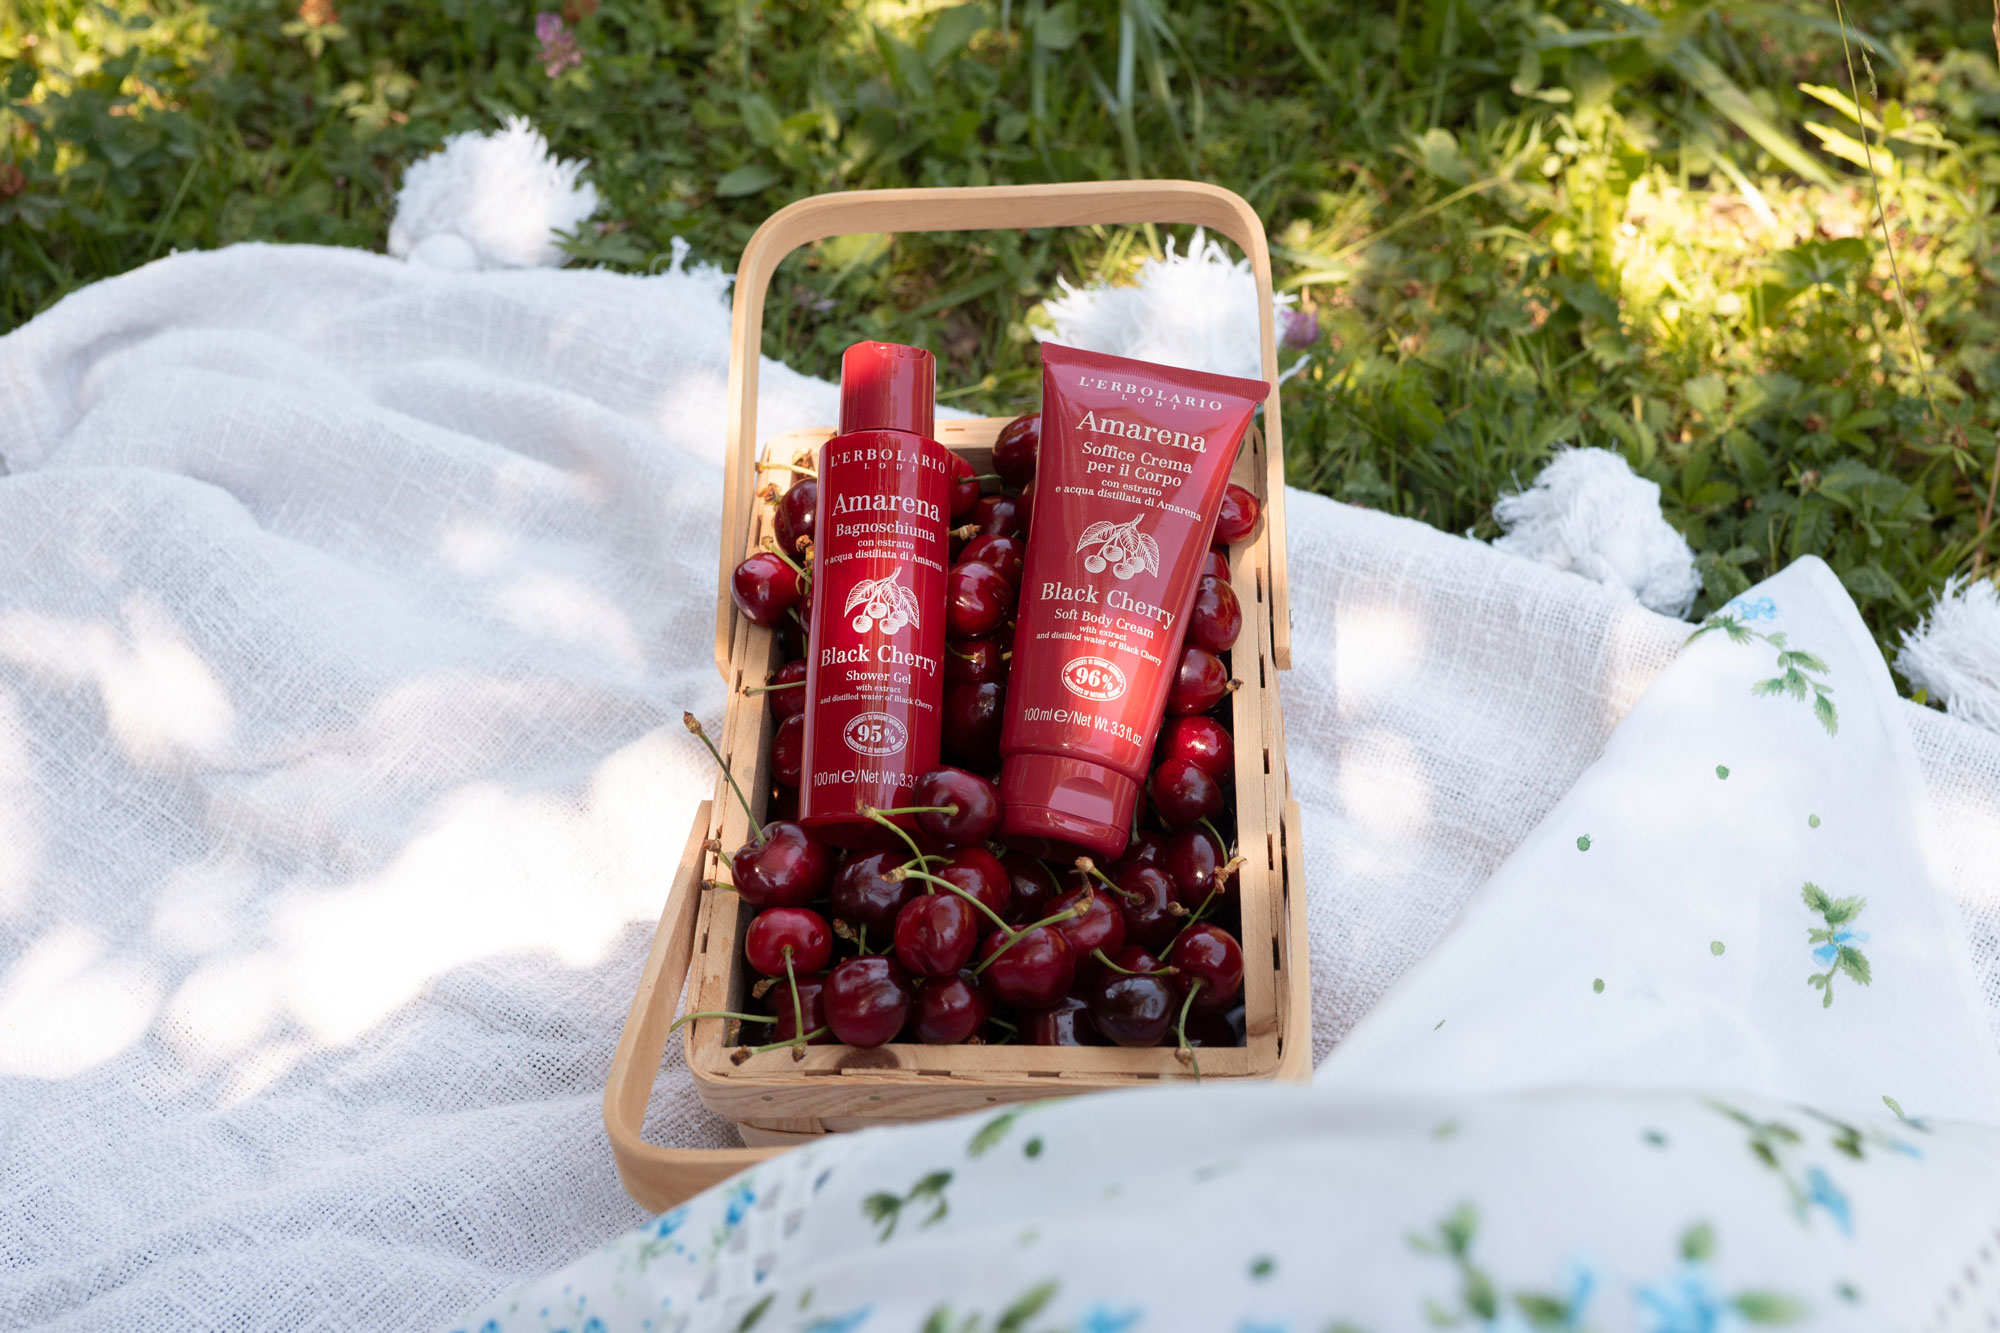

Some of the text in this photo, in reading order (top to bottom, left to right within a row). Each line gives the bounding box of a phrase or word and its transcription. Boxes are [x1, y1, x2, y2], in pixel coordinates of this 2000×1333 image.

[1079, 376, 1223, 411] L'ERBOLARIO
[1121, 394, 1177, 410] LODI
[1076, 410, 1207, 454] Amarena
[831, 448, 946, 474] L'ERBOLARIO
[864, 462, 916, 473] LODI
[1082, 442, 1193, 474] Soffice Crema
[1086, 460, 1182, 487] per il Corpo
[1101, 478, 1162, 497] con estratto
[832, 493, 940, 522] Amarena
[1064, 485, 1094, 498] acqua
[1097, 487, 1141, 505] distillata
[1144, 497, 1154, 507] di
[1156, 500, 1202, 522] Amarena
[836, 520, 936, 543] Bagnoschiuma
[857, 539, 914, 549] con estratto
[830, 552, 853, 564] acqua
[855, 549, 897, 559] distillata
[900, 551, 909, 560] di
[911, 553, 943, 572] Amarena
[1040, 582, 1175, 630] Black Cherry
[1054, 608, 1154, 640] Soft Body Cream
[1079, 625, 1127, 641] with extract
[821, 644, 937, 677] Black Cherry
[1051, 631, 1081, 641] distilled
[1083, 636, 1106, 646] water
[1108, 640, 1117, 648] of
[1118, 641, 1139, 655] Black
[1140, 650, 1162, 666] Cherry
[846, 670, 911, 684] Shower Gel
[874, 685, 901, 693] extract
[1075, 667, 1113, 691] 96%
[820, 693, 933, 712] and distilled water of Black Cherry
[857, 724, 896, 744] 95%
[1094, 714, 1109, 733] Wt.
[1110, 721, 1125, 738] 3.3
[882, 771, 898, 786] Wt.
[899, 774, 913, 788] 3.3
